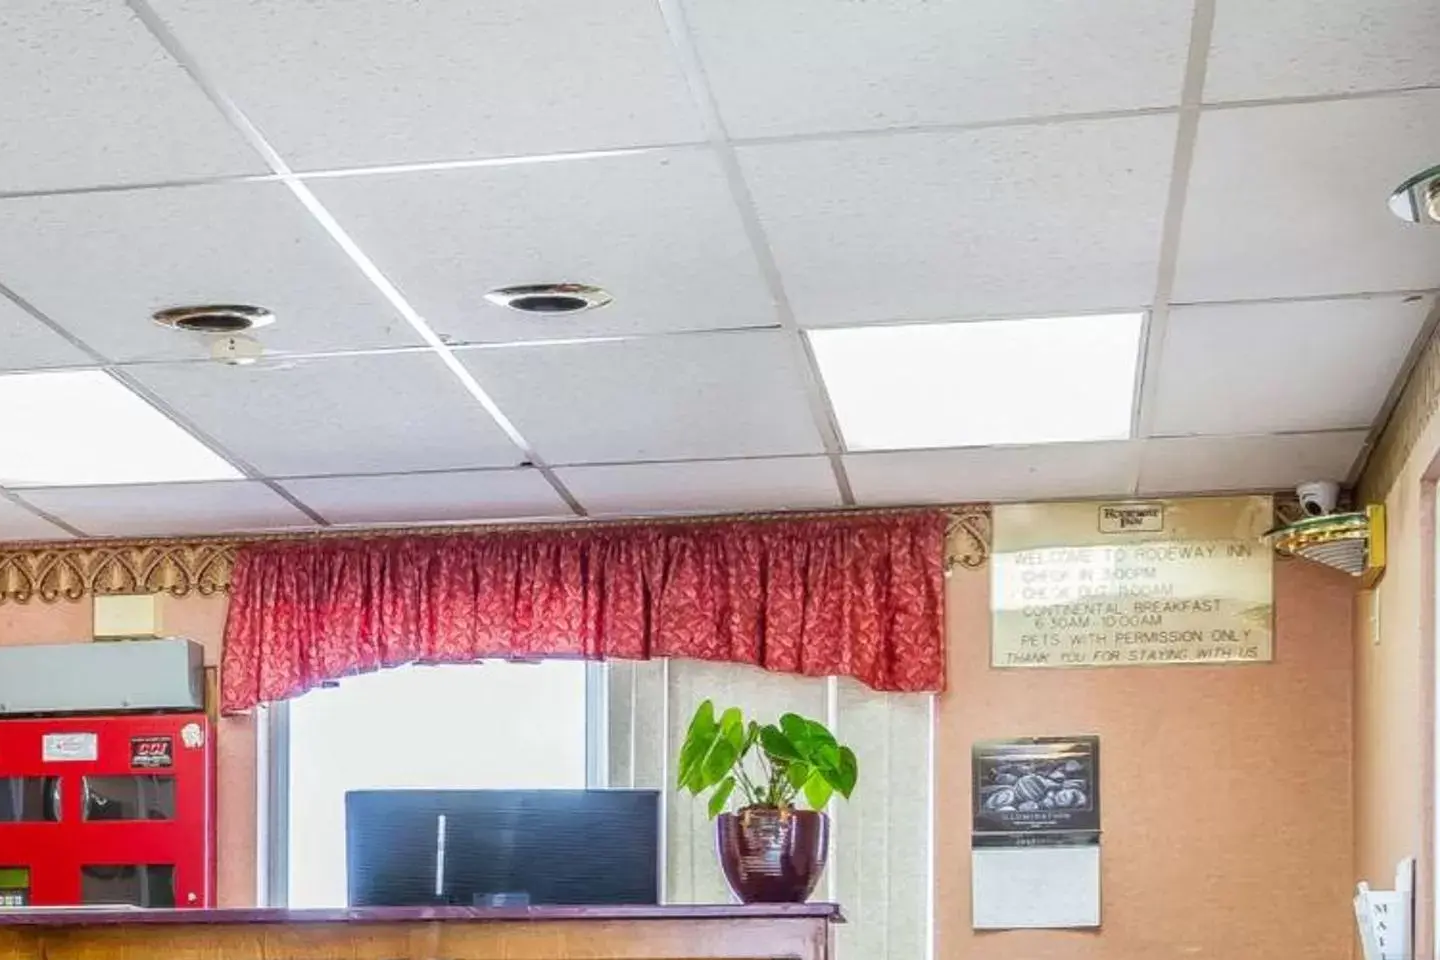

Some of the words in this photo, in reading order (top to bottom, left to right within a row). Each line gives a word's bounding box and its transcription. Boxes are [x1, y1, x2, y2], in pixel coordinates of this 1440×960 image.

[1106, 548, 1124, 562] TO
[1135, 545, 1216, 562] RODEWAY
[1226, 543, 1253, 557] INN
[1022, 602, 1122, 618] CONTINENTAL
[1133, 599, 1222, 614] BREAKFAST
[1020, 633, 1061, 647] PETS
[1071, 632, 1107, 646] WITH
[1115, 629, 1203, 645] PERMISSION
[1211, 628, 1252, 643] ONLY
[1006, 650, 1050, 664] THANK
[1060, 649, 1085, 663] YOU
[1093, 648, 1120, 662] FOR
[1127, 647, 1188, 662] STAYING
[1196, 646, 1232, 660] WITH
[1238, 644, 1259, 659] US
